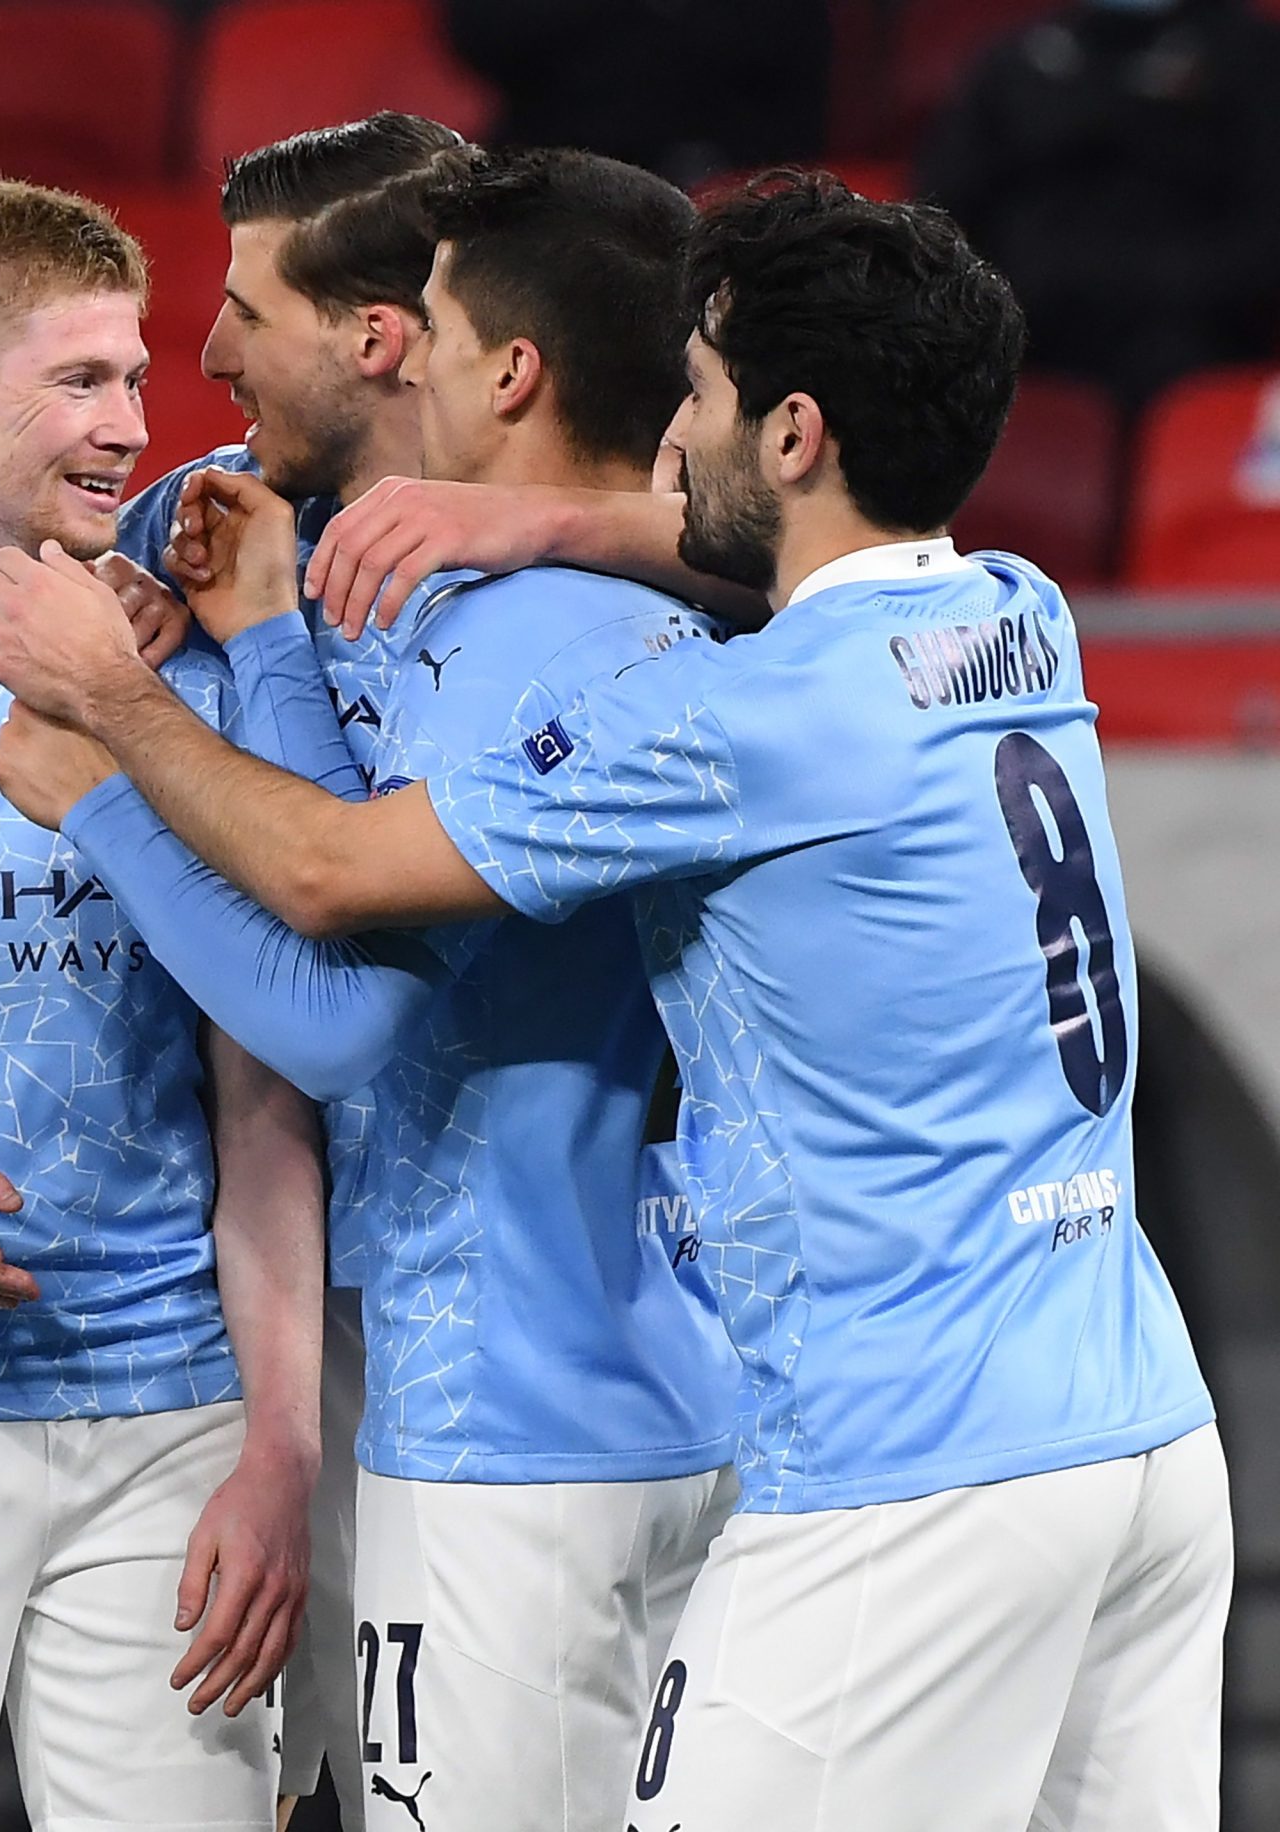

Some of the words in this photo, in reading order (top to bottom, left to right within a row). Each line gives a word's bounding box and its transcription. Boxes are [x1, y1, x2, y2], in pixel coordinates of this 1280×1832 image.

[995, 731, 1127, 1119] 8
[671, 1233, 703, 1269] FO
[1052, 1215, 1092, 1253] FOR
[357, 1620, 424, 1764] 27
[636, 1659, 687, 1801] 8
